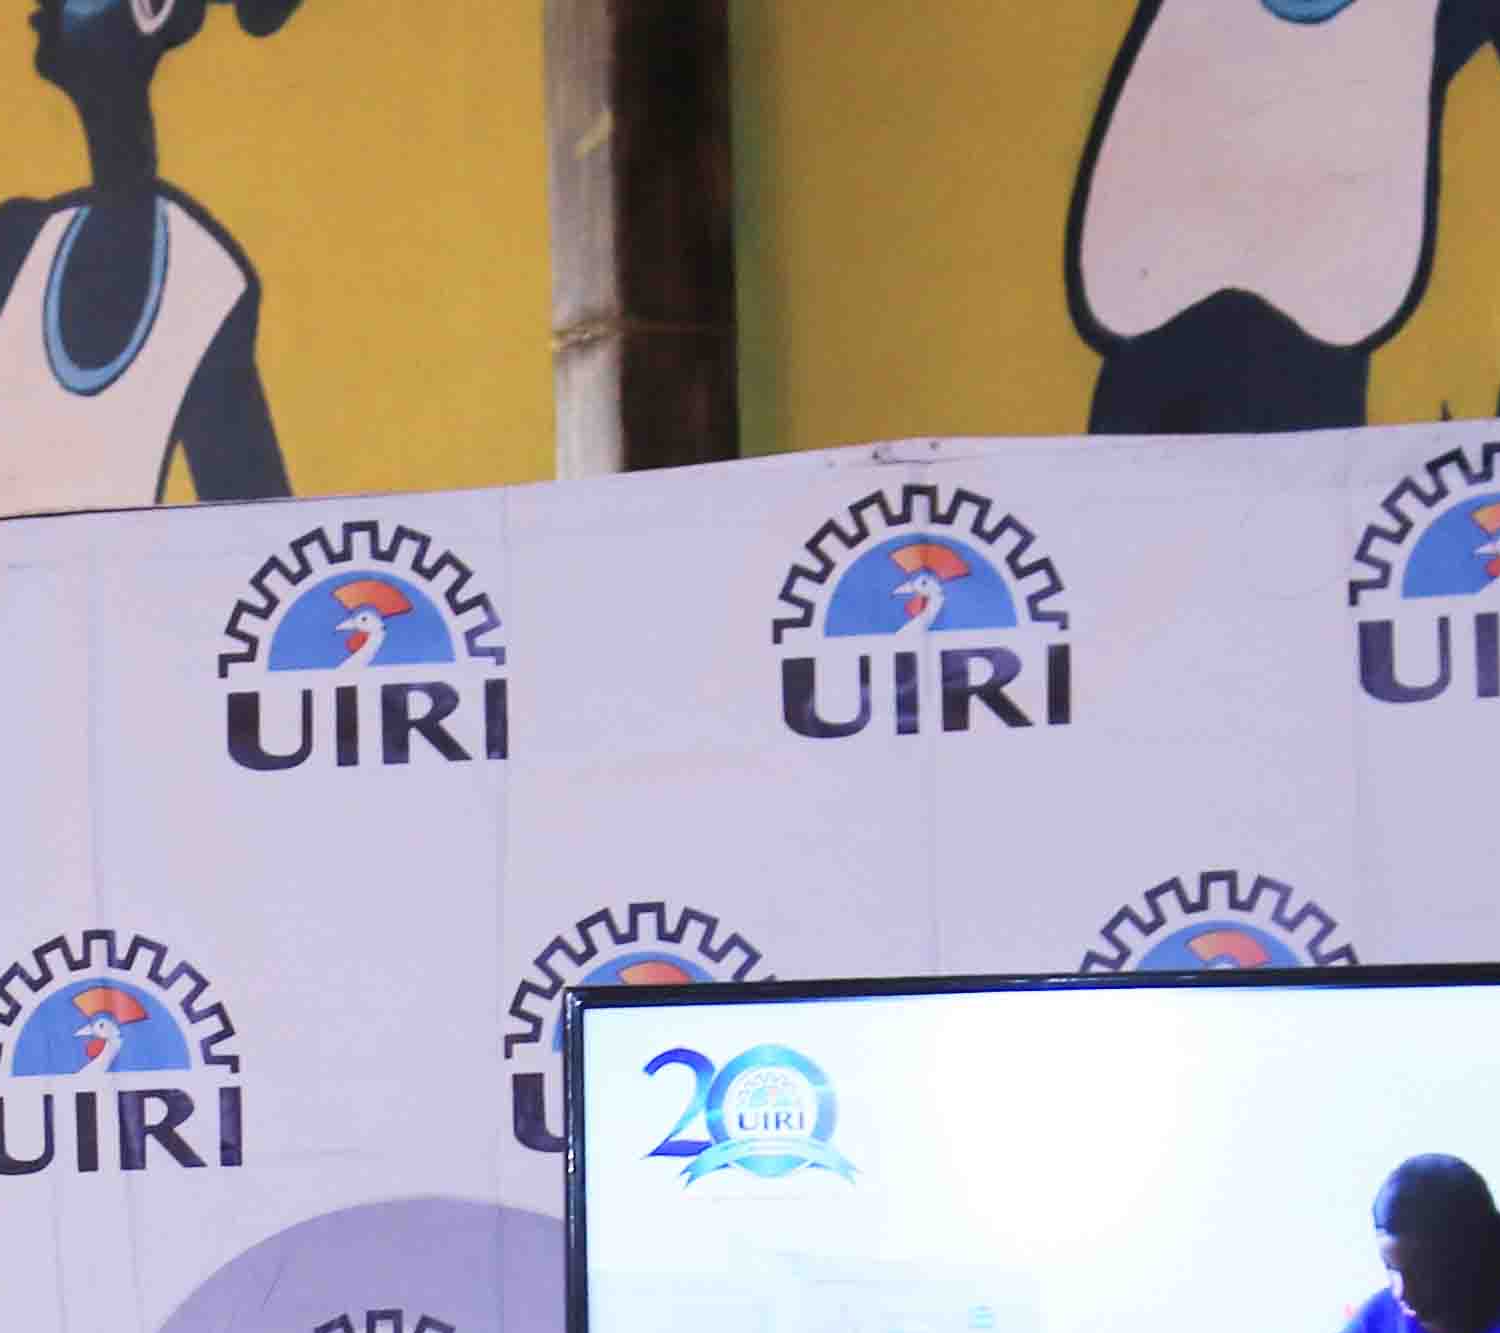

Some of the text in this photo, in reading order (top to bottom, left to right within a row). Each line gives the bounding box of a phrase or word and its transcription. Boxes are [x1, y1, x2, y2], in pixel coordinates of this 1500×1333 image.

[227, 682, 508, 771] UIRI
[781, 643, 1071, 740] UIRI
[738, 1110, 806, 1131] UIRI
